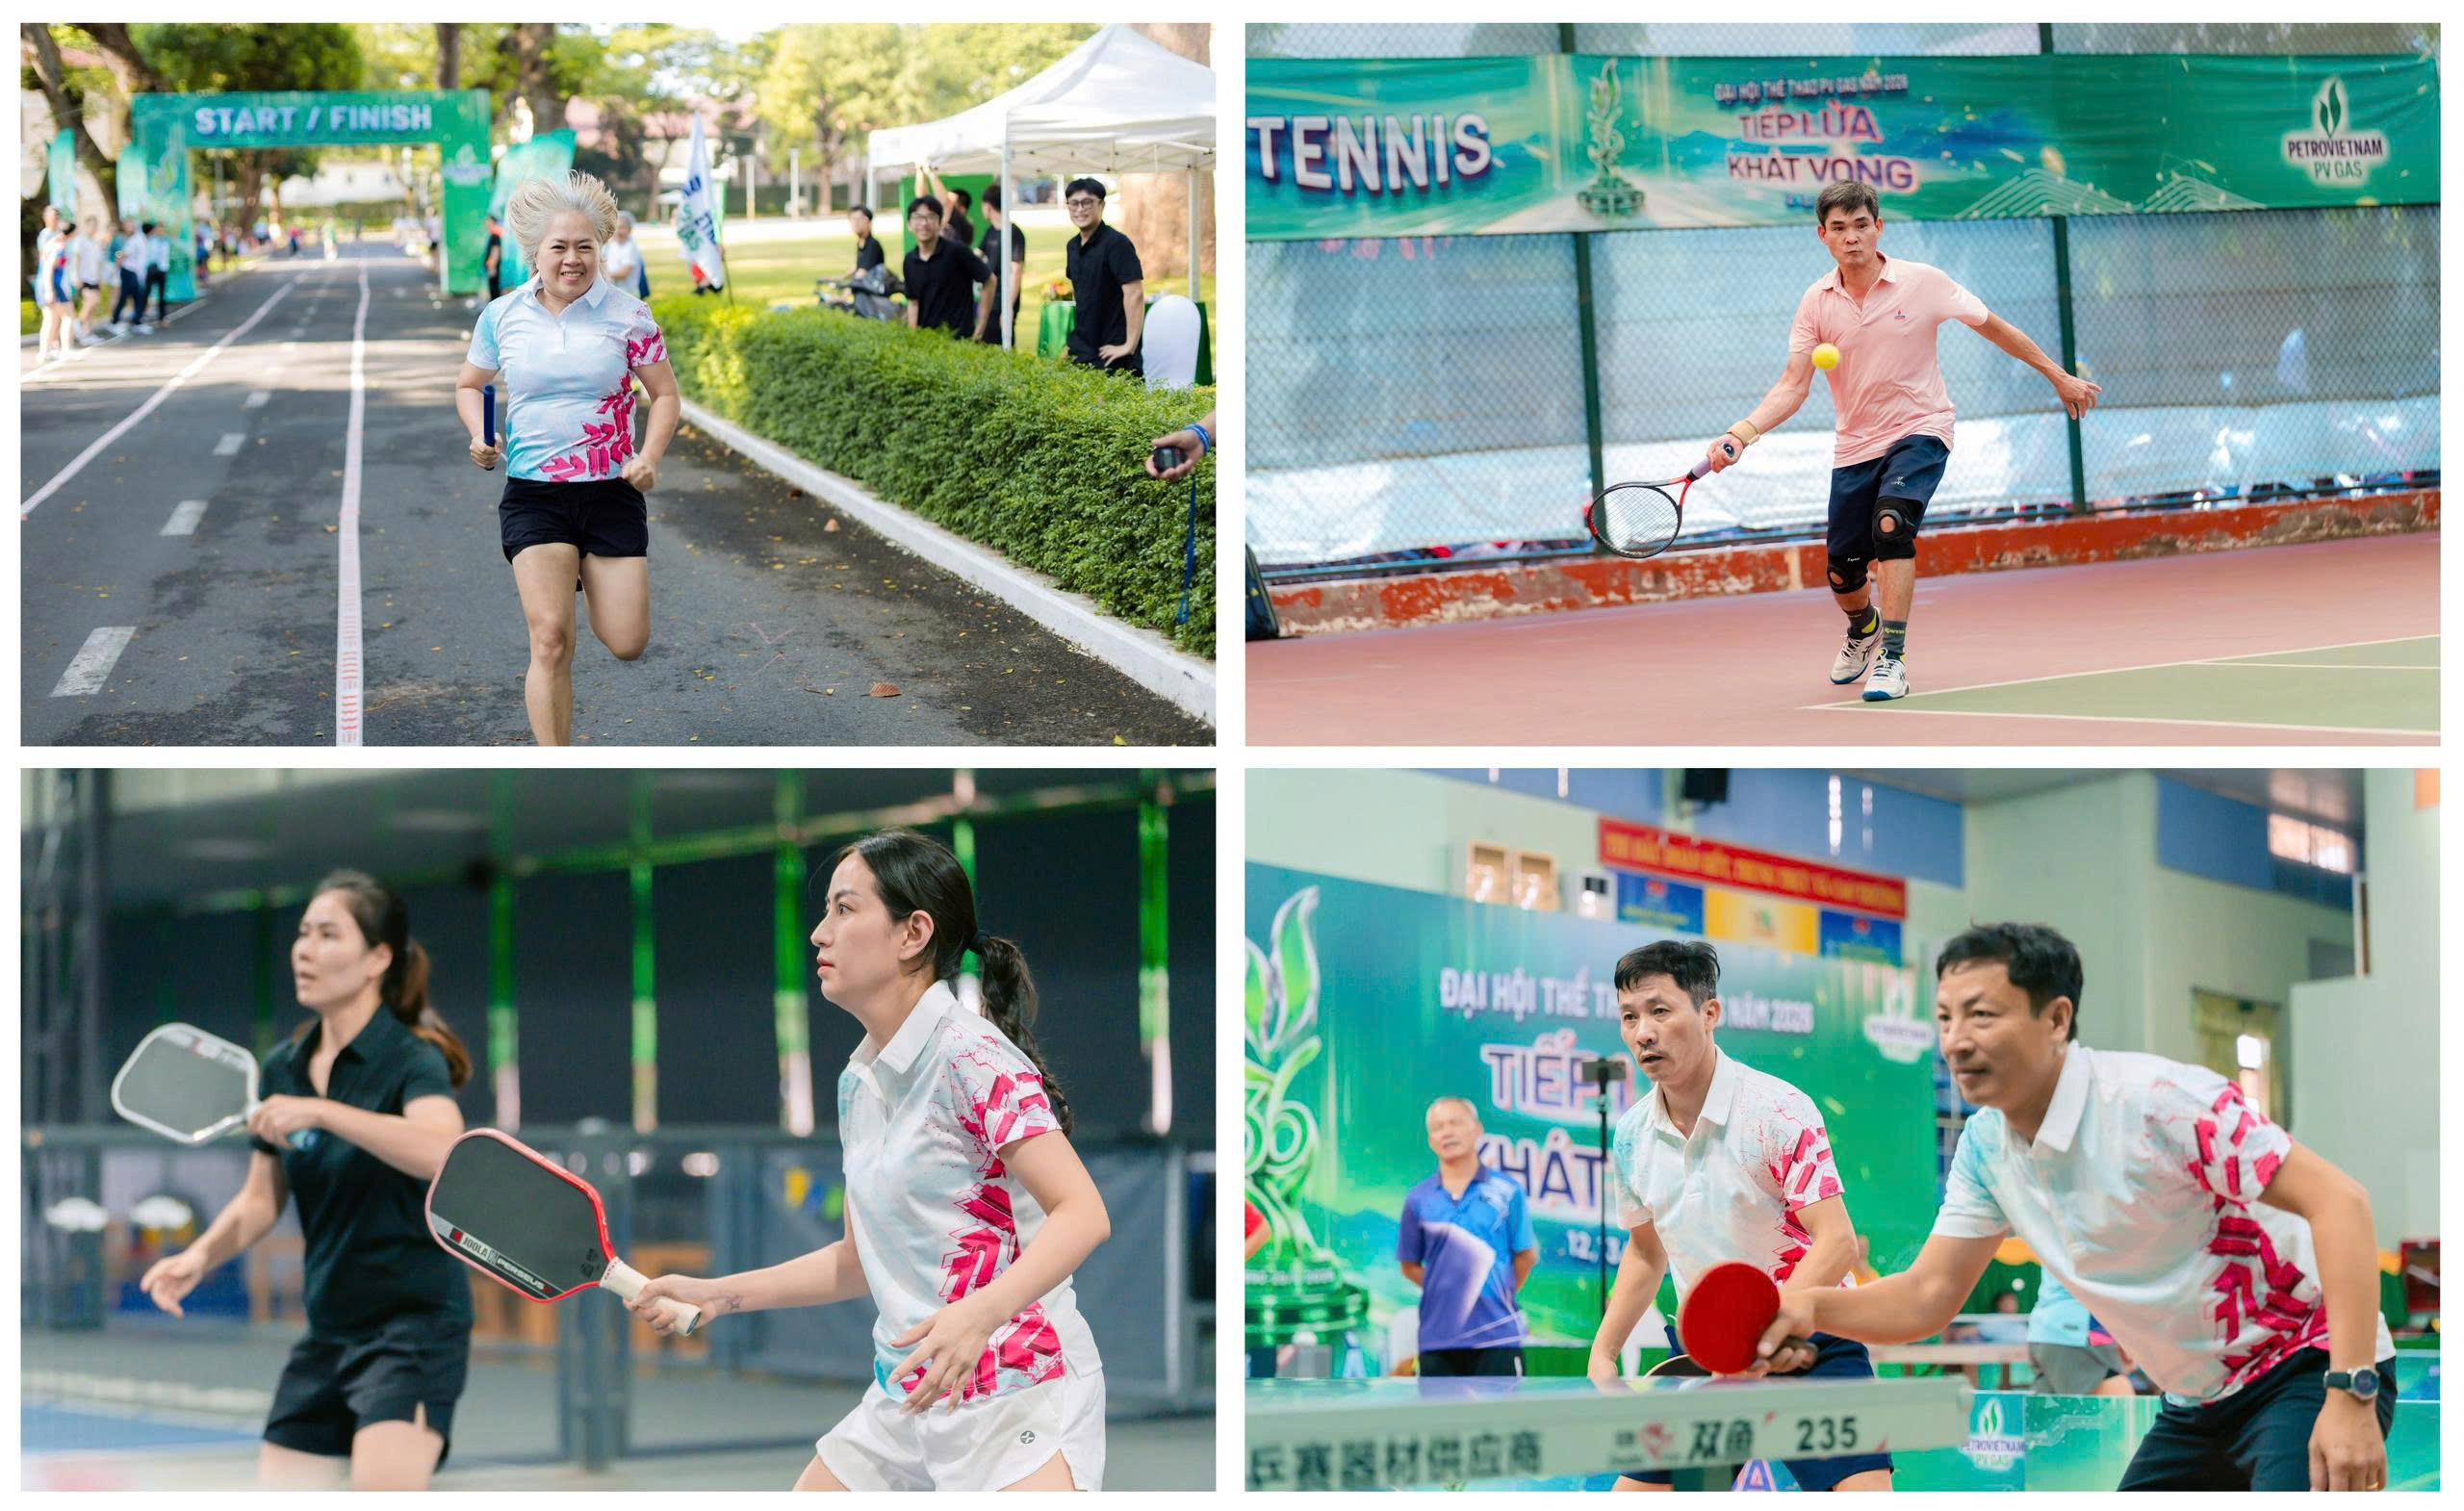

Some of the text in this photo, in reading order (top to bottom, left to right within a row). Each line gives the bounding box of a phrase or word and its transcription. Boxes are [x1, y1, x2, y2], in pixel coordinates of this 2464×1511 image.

[194, 106, 297, 135] START
[329, 103, 432, 131] FINISH
[1245, 112, 1491, 192] TENNIS
[2288, 136, 2383, 158] PETROVIETNAM
[2314, 159, 2363, 180] PV GAS
[1440, 966, 1489, 1020] ĐẠI
[1493, 965, 1537, 1023] HỘI
[462, 1237, 545, 1291] JOOLA PERSEUS
[1688, 1416, 1860, 1460] 双鱼 235
